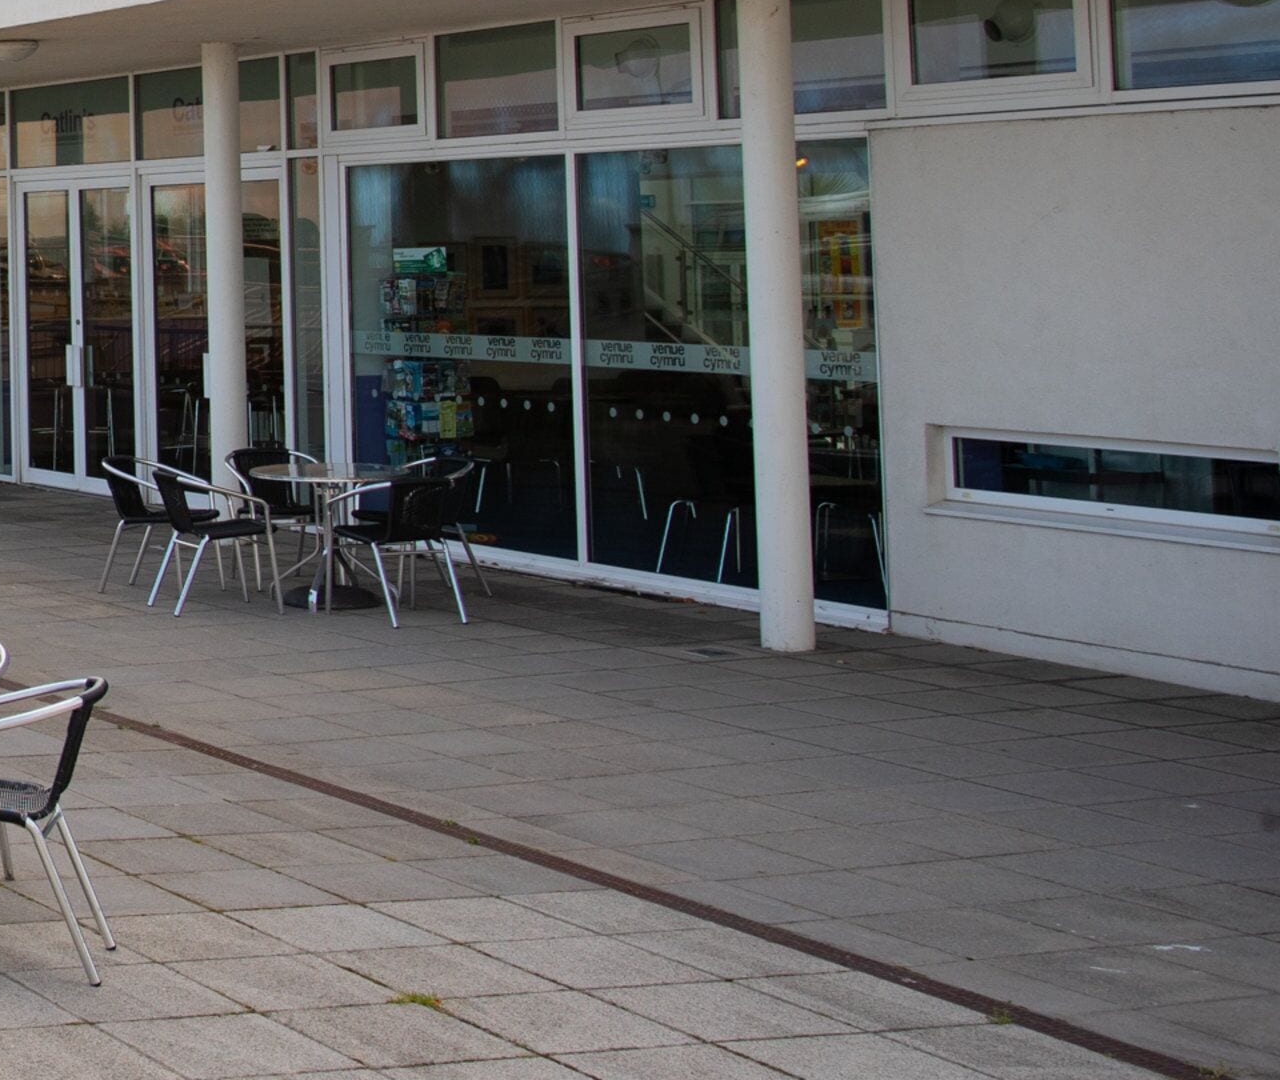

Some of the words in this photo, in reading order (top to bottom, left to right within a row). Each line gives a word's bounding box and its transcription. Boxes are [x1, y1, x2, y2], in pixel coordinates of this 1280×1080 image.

[404, 333, 431, 344] venue
[445, 334, 472, 345] venue
[487, 337, 516, 347] venue
[532, 338, 561, 349] venue
[403, 343, 432, 355] cymru
[443, 344, 473, 356] cymru
[486, 346, 517, 359] cymru
[601, 342, 632, 353] venue
[651, 343, 685, 355] venue
[530, 348, 562, 361] cymru
[599, 352, 634, 365] cymru
[821, 351, 862, 363] venue
[650, 354, 686, 368] cymru
[820, 363, 862, 377] cymru
